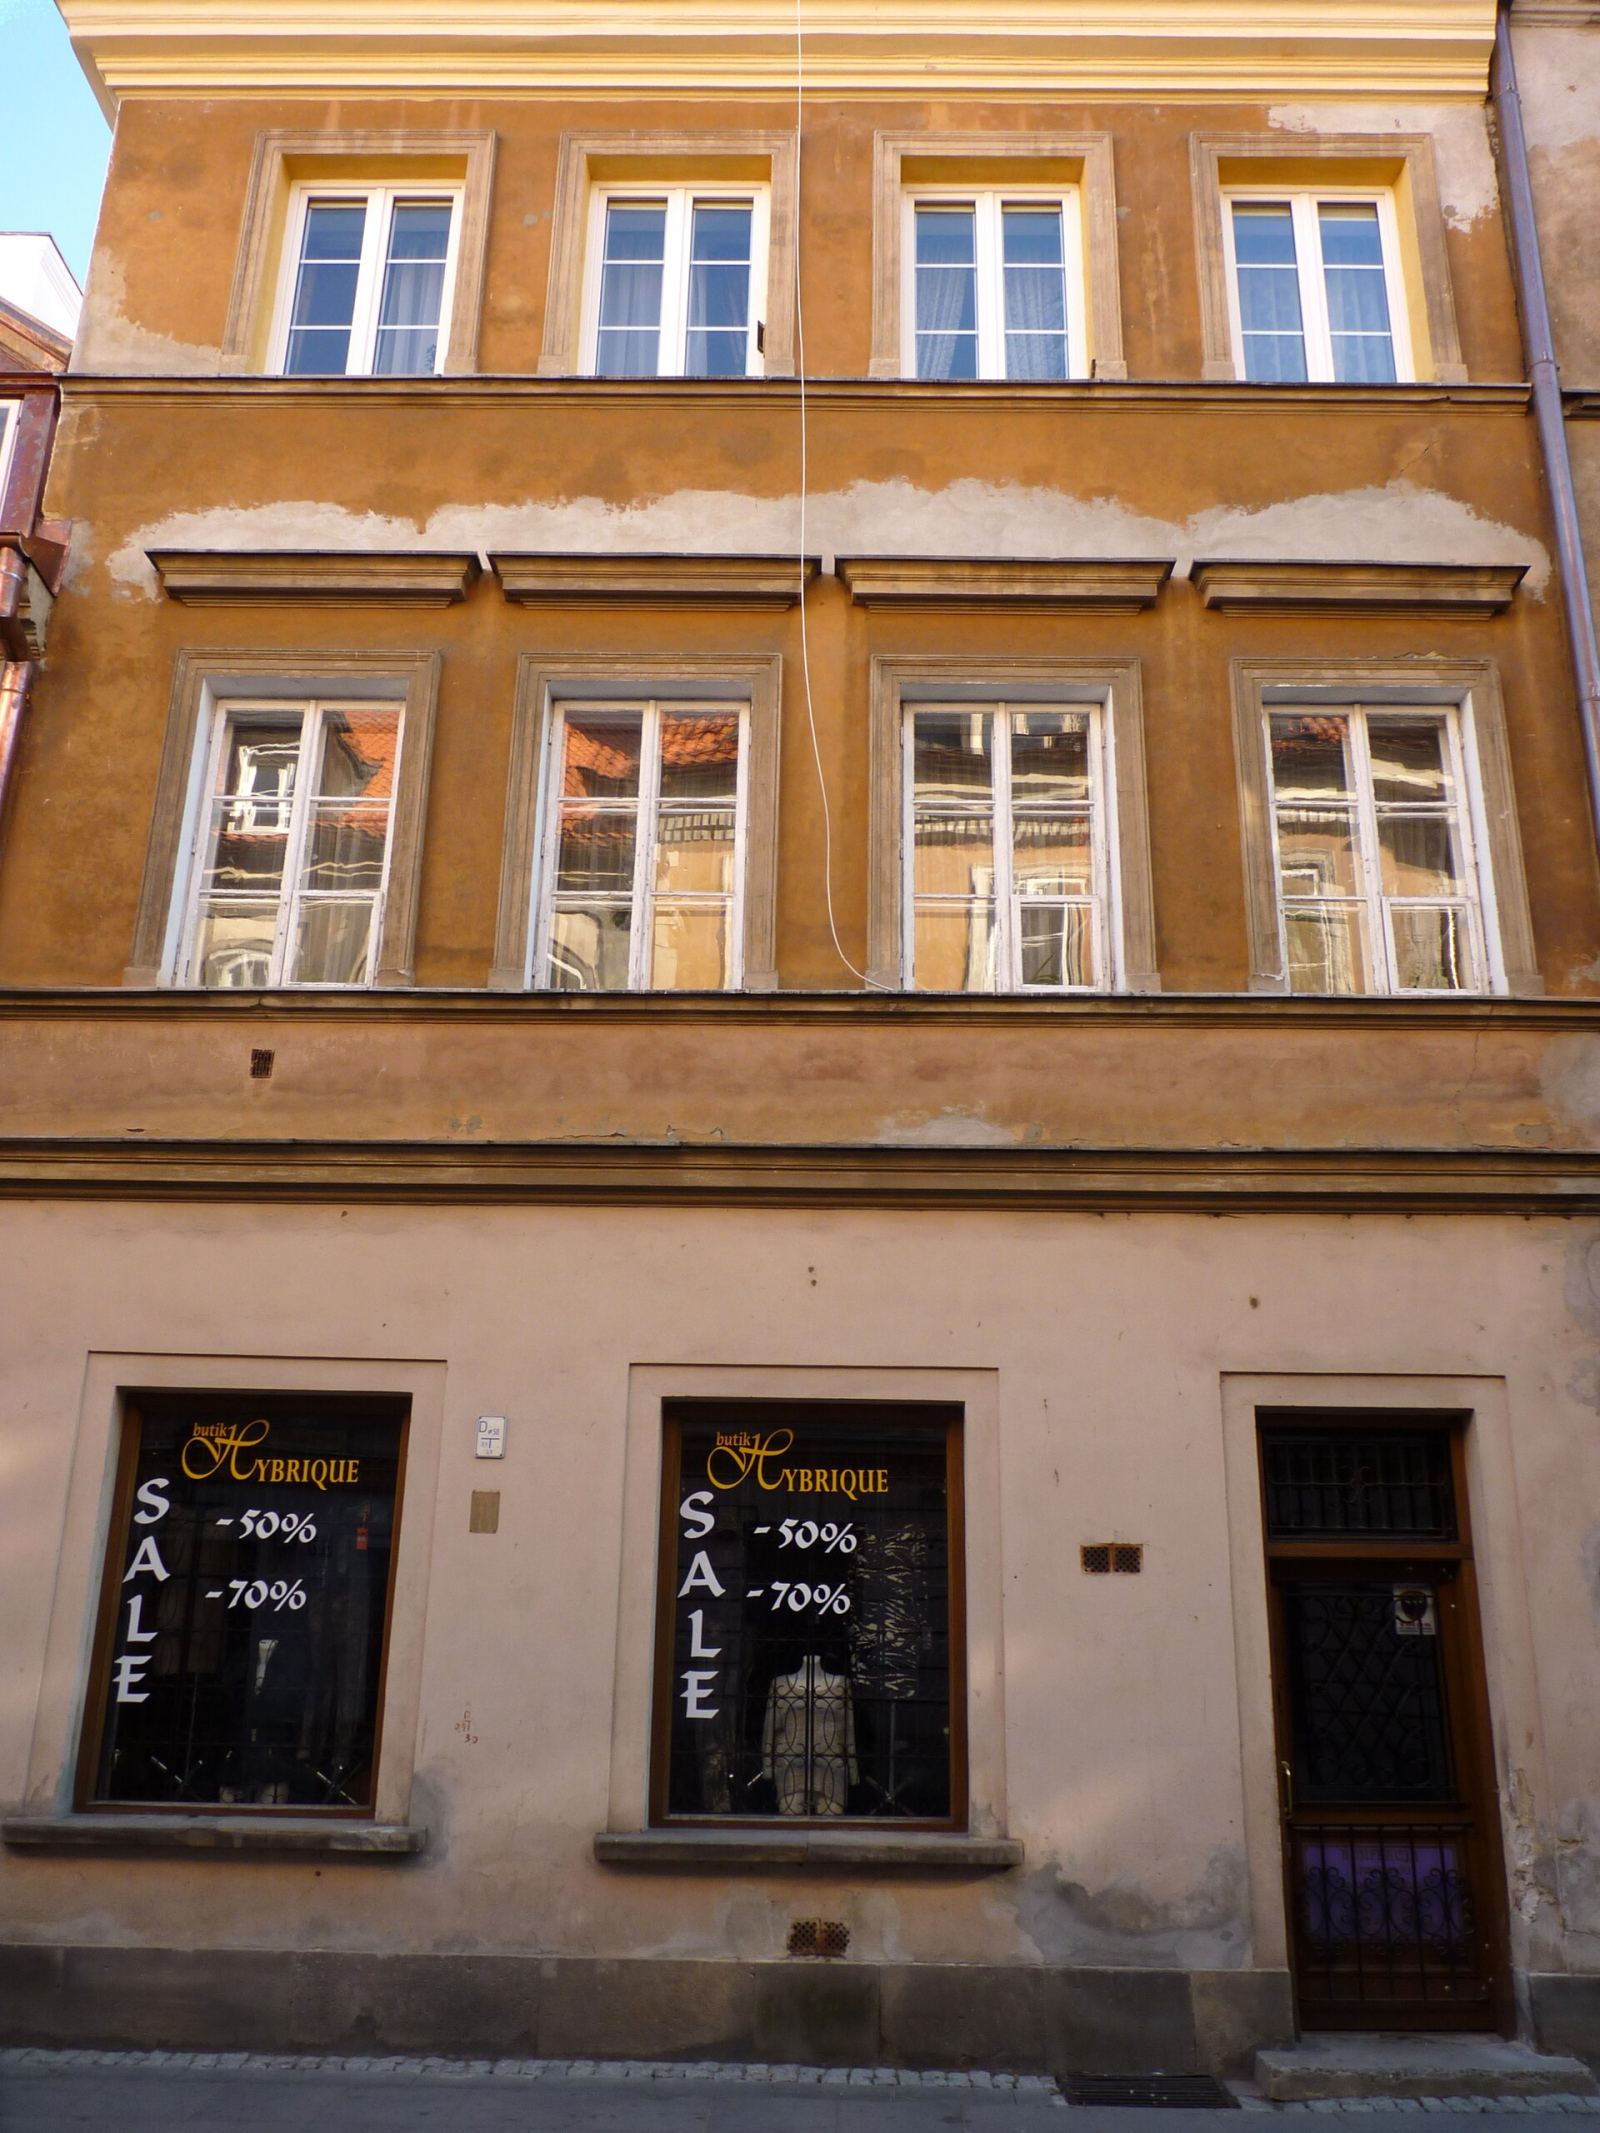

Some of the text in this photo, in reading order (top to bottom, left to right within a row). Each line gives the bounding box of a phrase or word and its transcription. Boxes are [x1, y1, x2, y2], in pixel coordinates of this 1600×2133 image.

[182, 1419, 360, 1490] HYBRIQUE
[193, 1422, 228, 1437] butik
[707, 1428, 889, 1500] HYBRIQUE
[716, 1431, 751, 1446] butik
[113, 1477, 170, 1703] SALE
[677, 1490, 727, 1719] SALE
